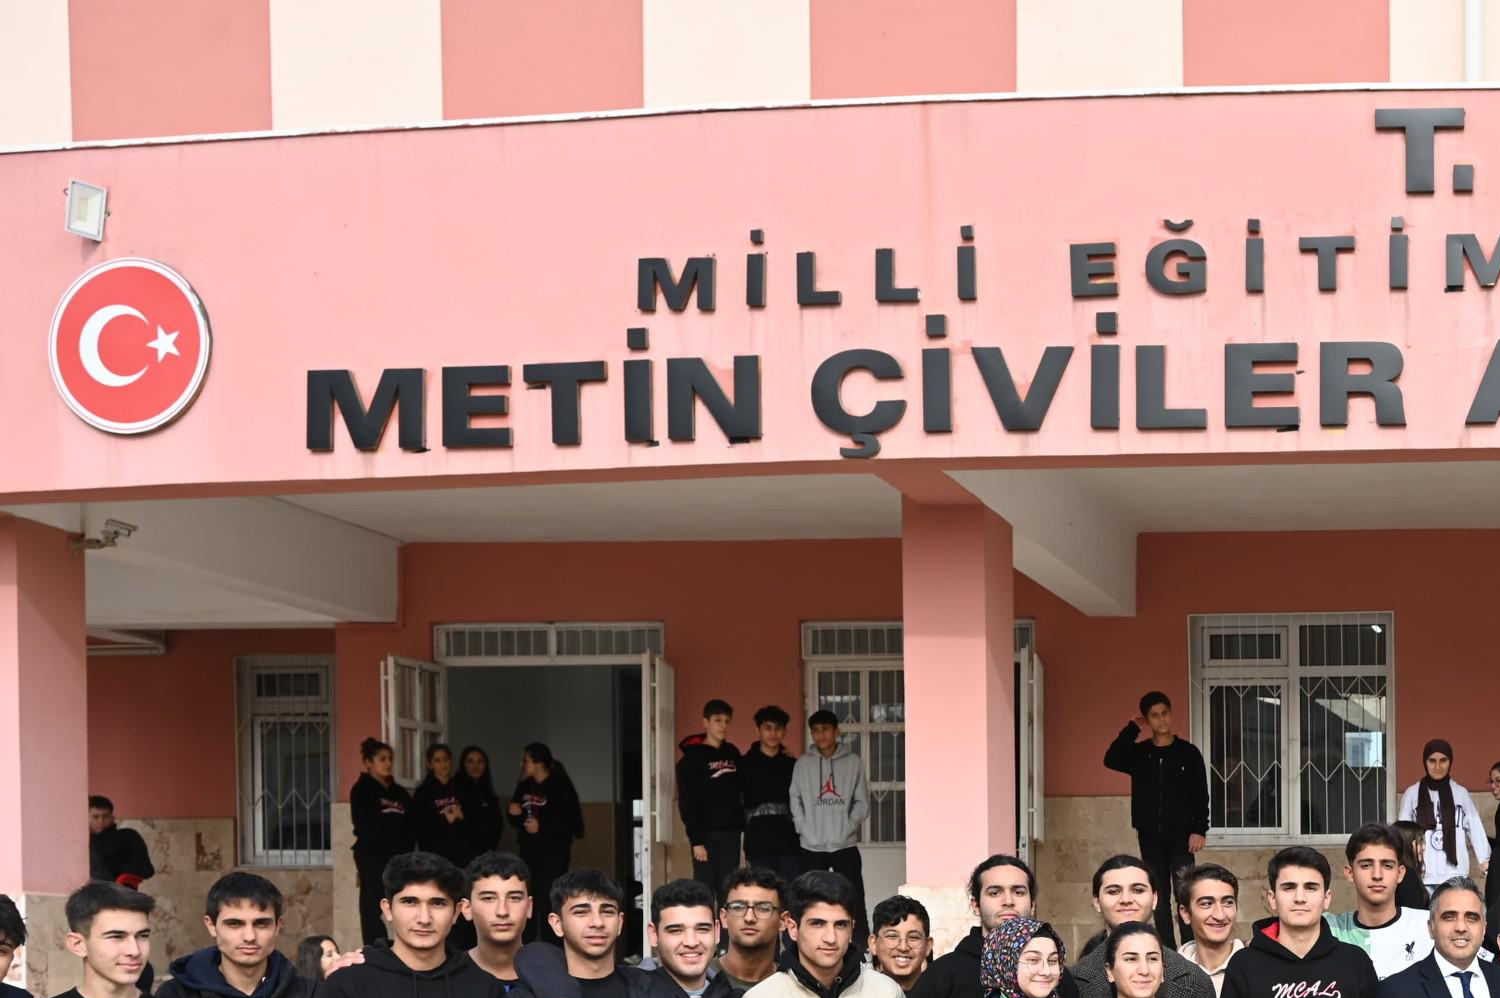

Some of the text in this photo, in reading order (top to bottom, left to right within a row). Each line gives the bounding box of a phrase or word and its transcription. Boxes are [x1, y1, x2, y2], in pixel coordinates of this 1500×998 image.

[1375, 107, 1474, 194] T.
[637, 225, 977, 312] MİLLİ
[306, 327, 763, 452] METİN
[811, 311, 1407, 459] ÇİVİLER
